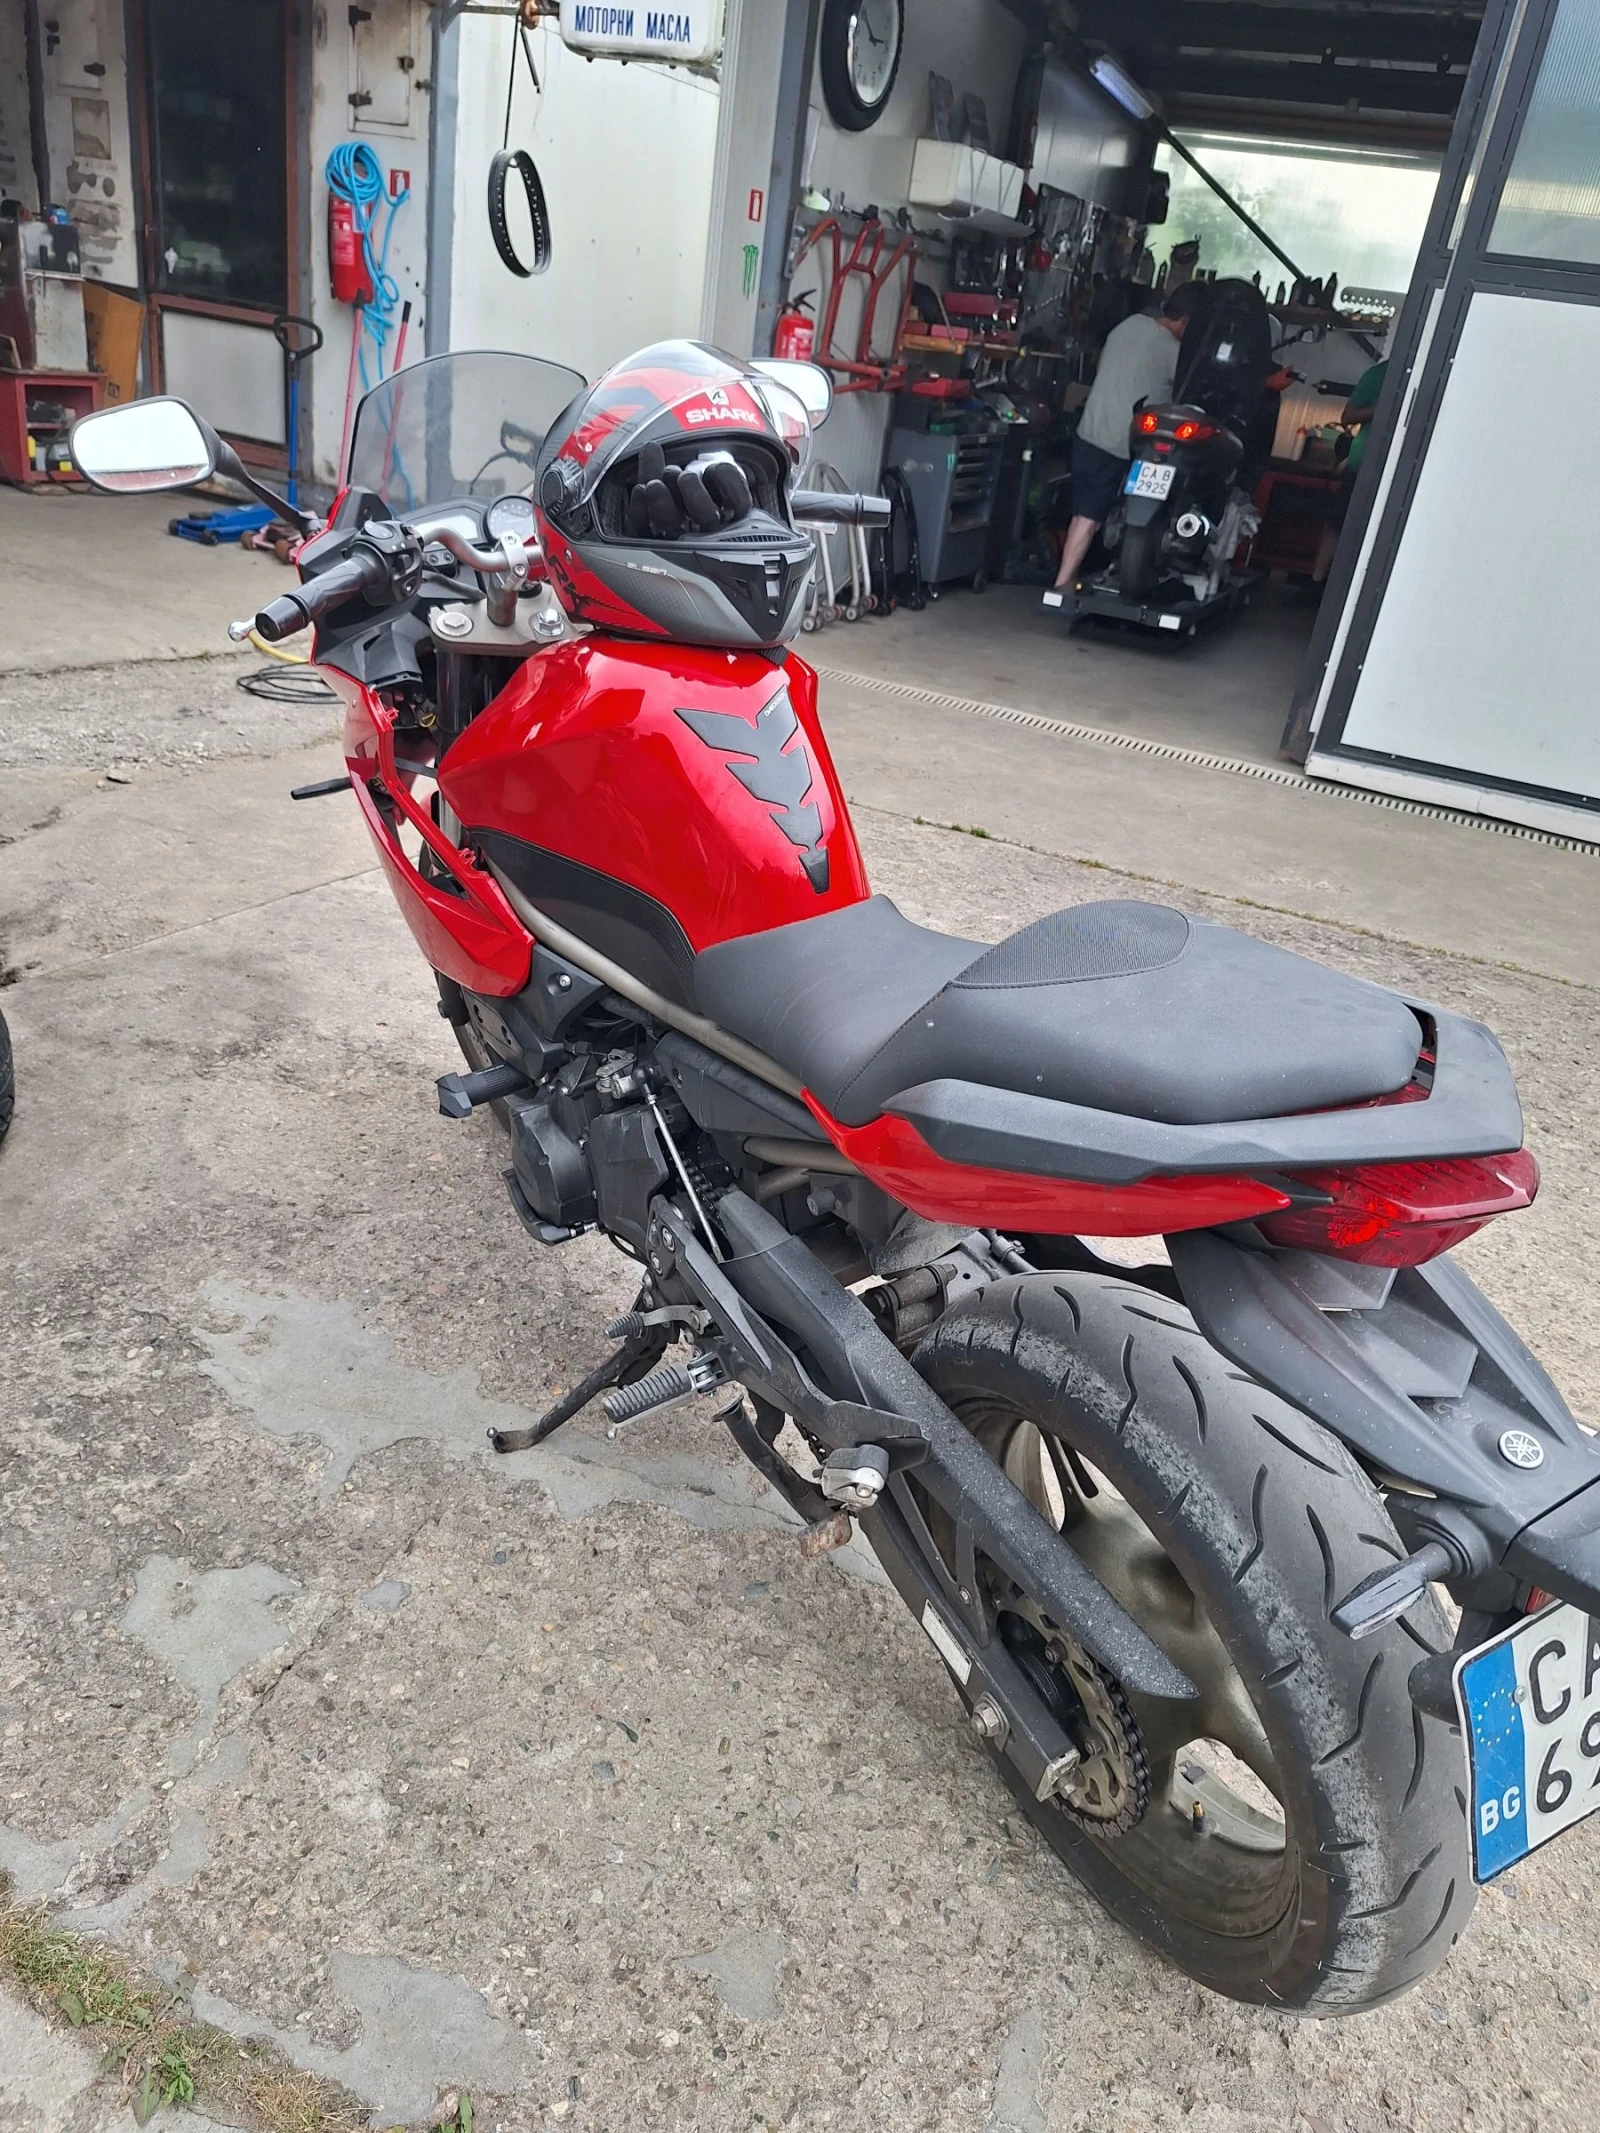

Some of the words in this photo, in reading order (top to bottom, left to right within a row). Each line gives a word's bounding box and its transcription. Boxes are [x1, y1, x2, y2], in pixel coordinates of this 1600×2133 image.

[575, 5, 634, 37] МОТОРНИ
[646, 12, 691, 43] МАСЛА
[685, 406, 760, 425] SHARK
[1141, 466, 1157, 479] CA
[1162, 470, 1171, 481] B
[1136, 480, 1167, 495] 2925
[1480, 1785, 1521, 1837] BG
